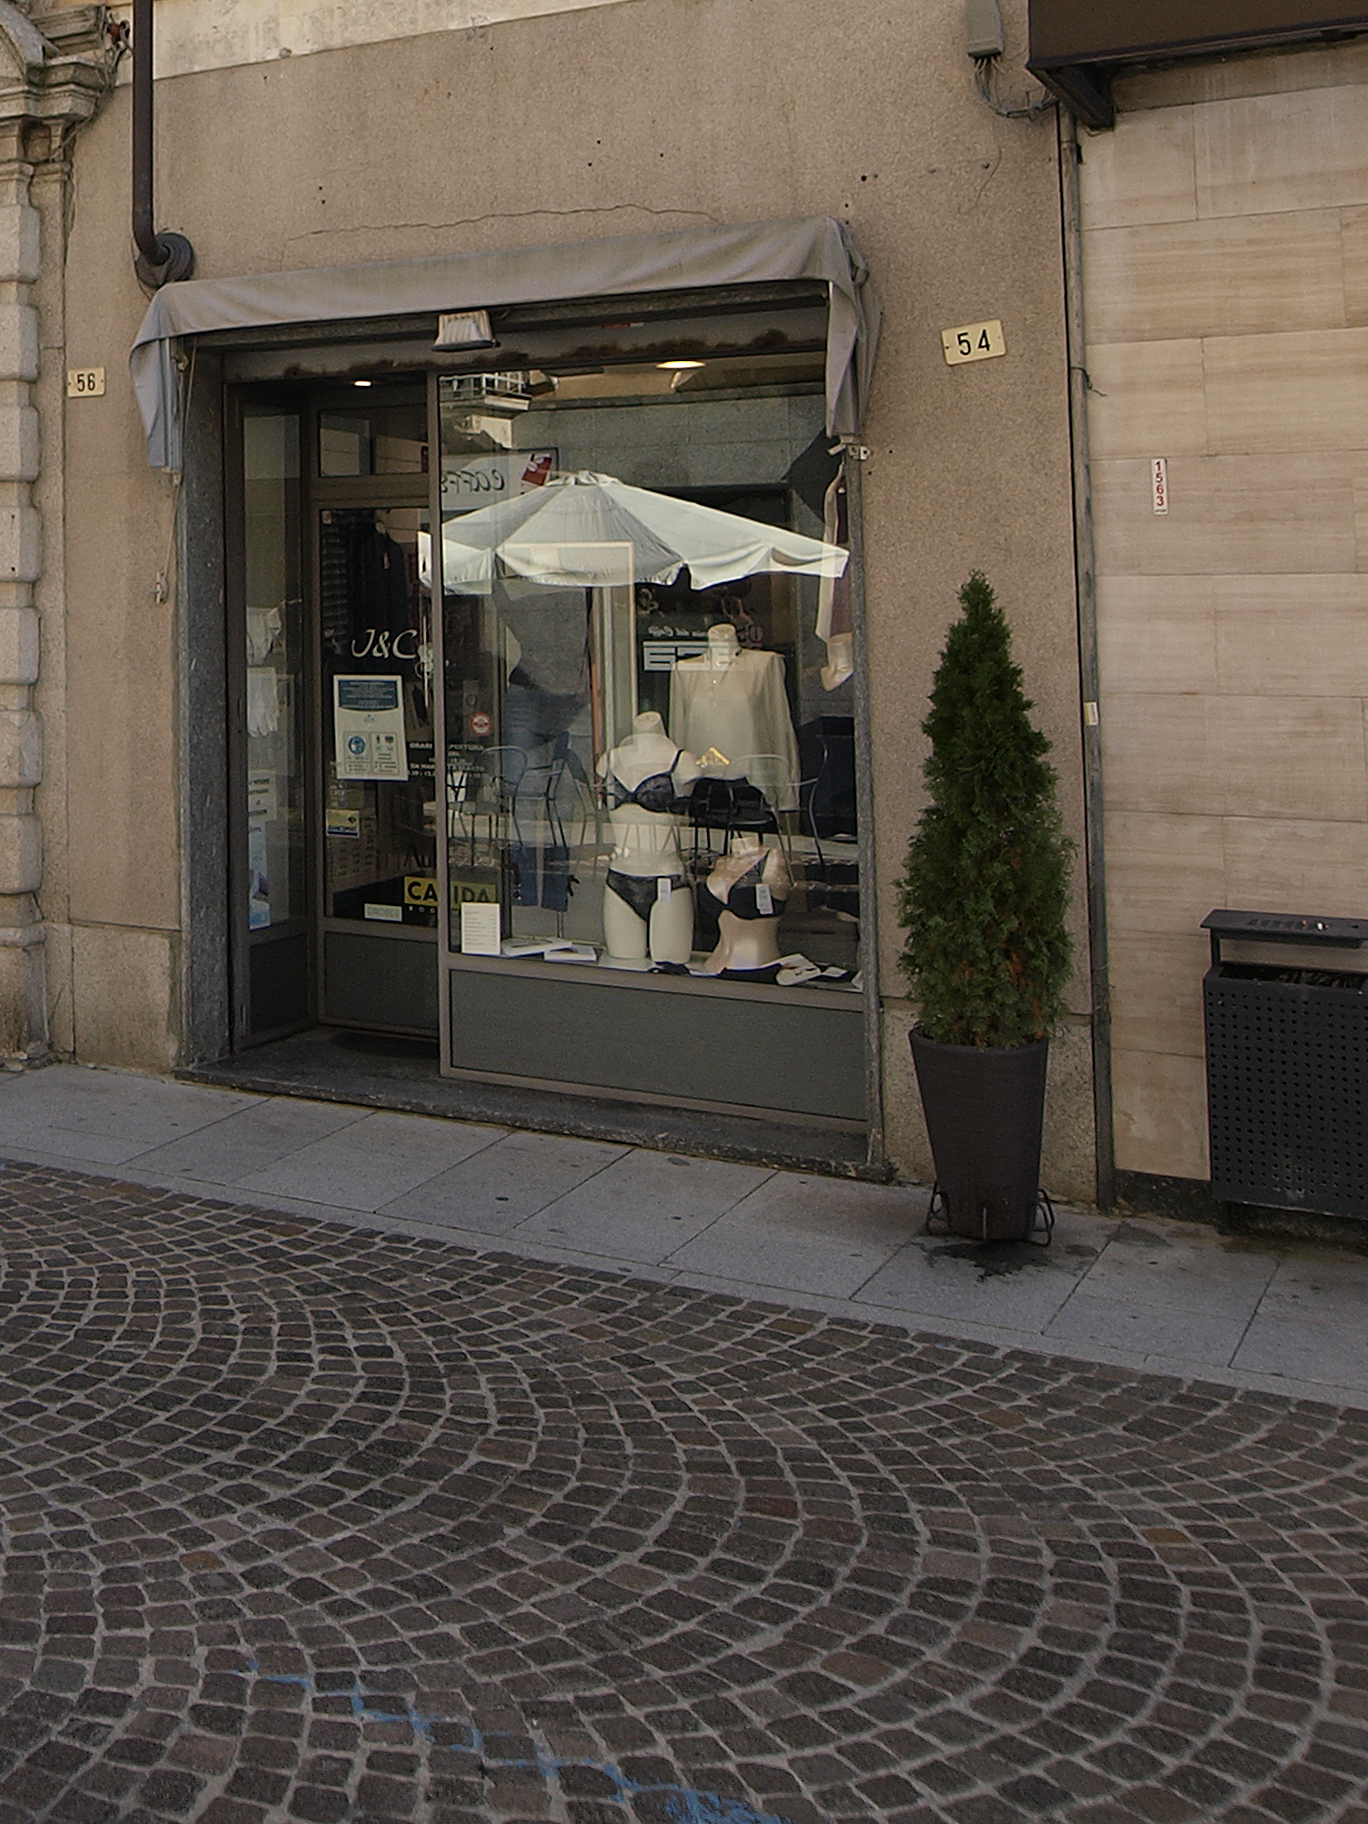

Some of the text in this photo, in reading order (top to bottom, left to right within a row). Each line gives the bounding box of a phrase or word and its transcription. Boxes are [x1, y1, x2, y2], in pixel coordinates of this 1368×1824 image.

[957, 328, 991, 356] 54
[77, 372, 96, 392] 56
[407, 881, 490, 903] CAIDA
